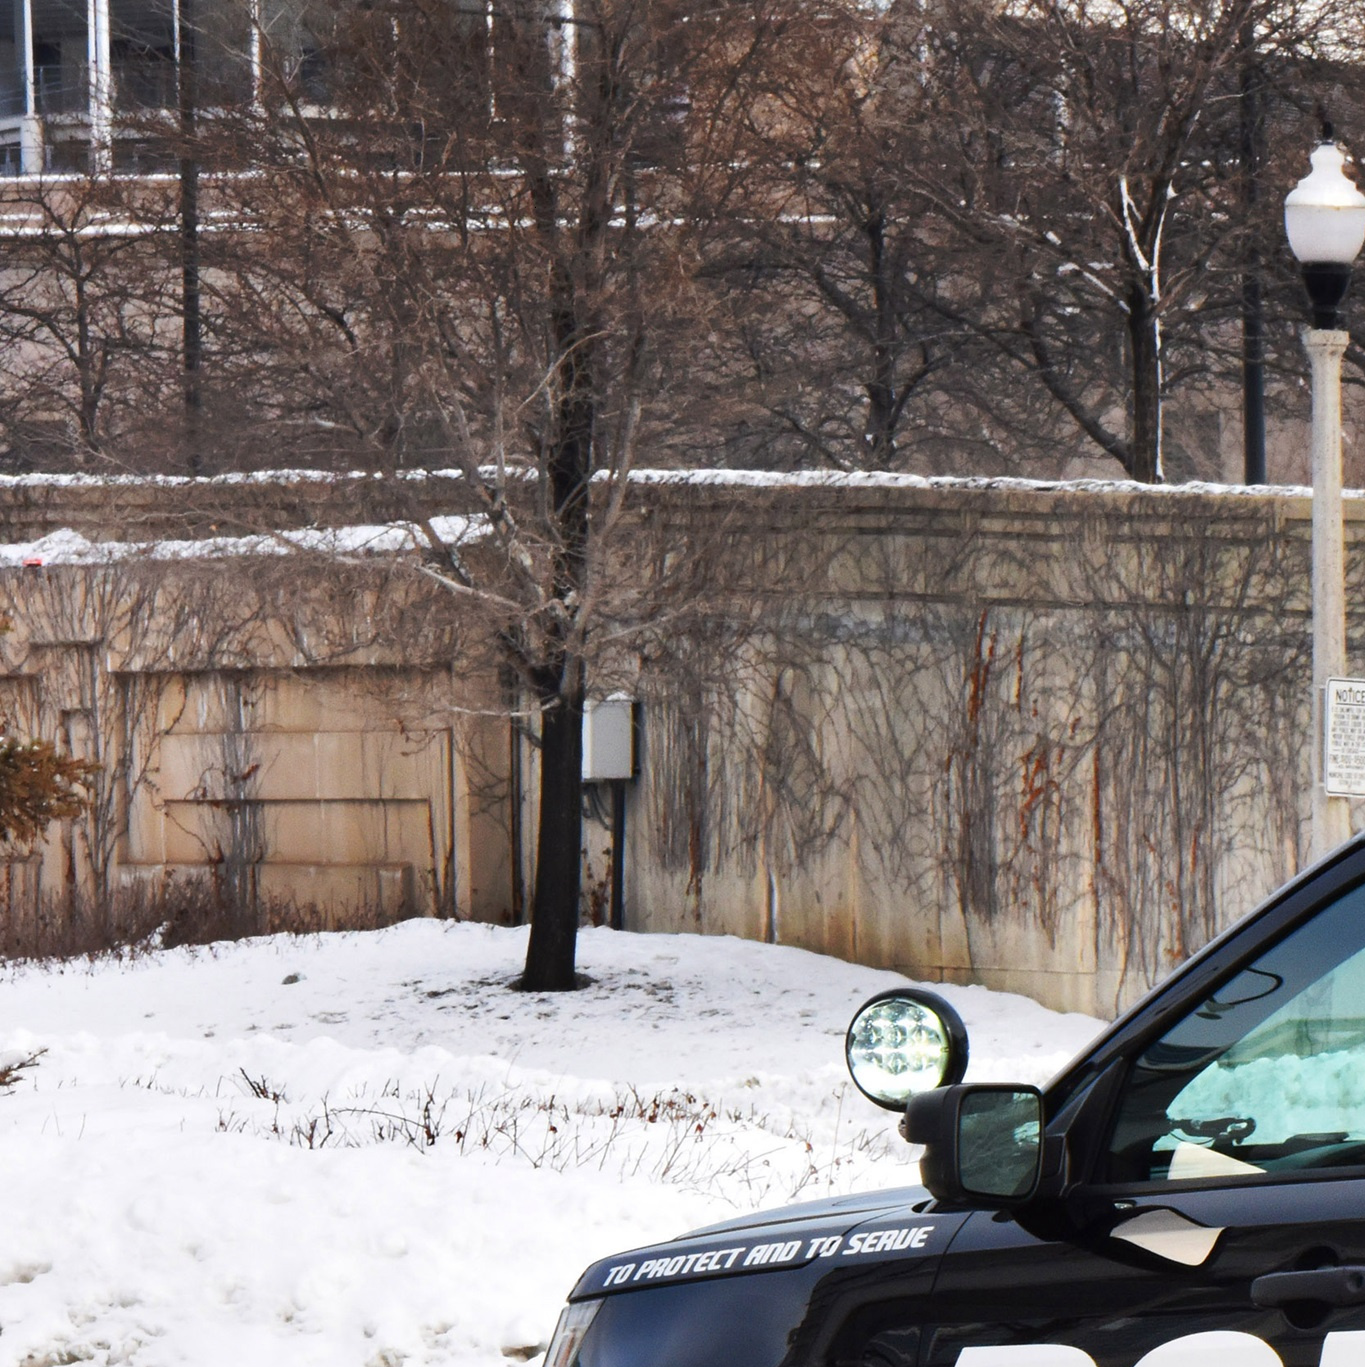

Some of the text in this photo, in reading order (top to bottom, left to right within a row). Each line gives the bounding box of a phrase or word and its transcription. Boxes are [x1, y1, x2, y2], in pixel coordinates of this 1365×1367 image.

[602, 1226, 935, 1288] TO PROTECT AND TO SERVE
